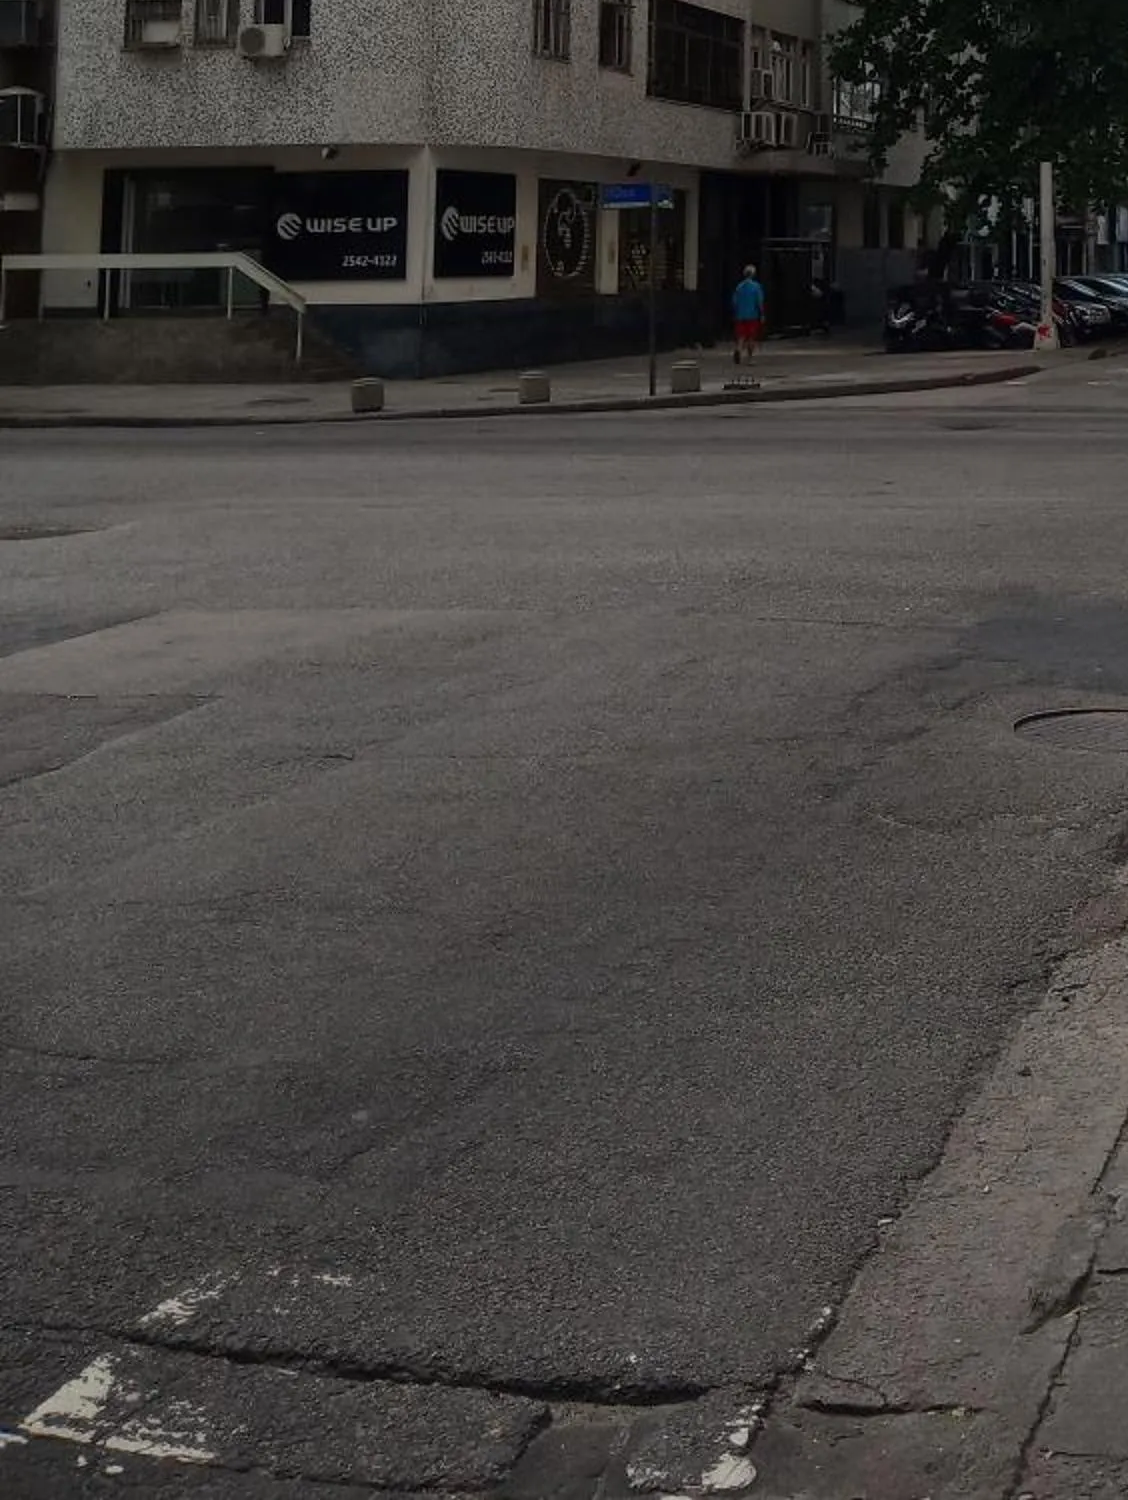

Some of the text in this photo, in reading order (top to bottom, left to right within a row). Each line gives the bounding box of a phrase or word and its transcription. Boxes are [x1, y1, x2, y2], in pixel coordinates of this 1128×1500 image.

[305, 217, 398, 233] WISE UP
[459, 215, 515, 233] WISE UP
